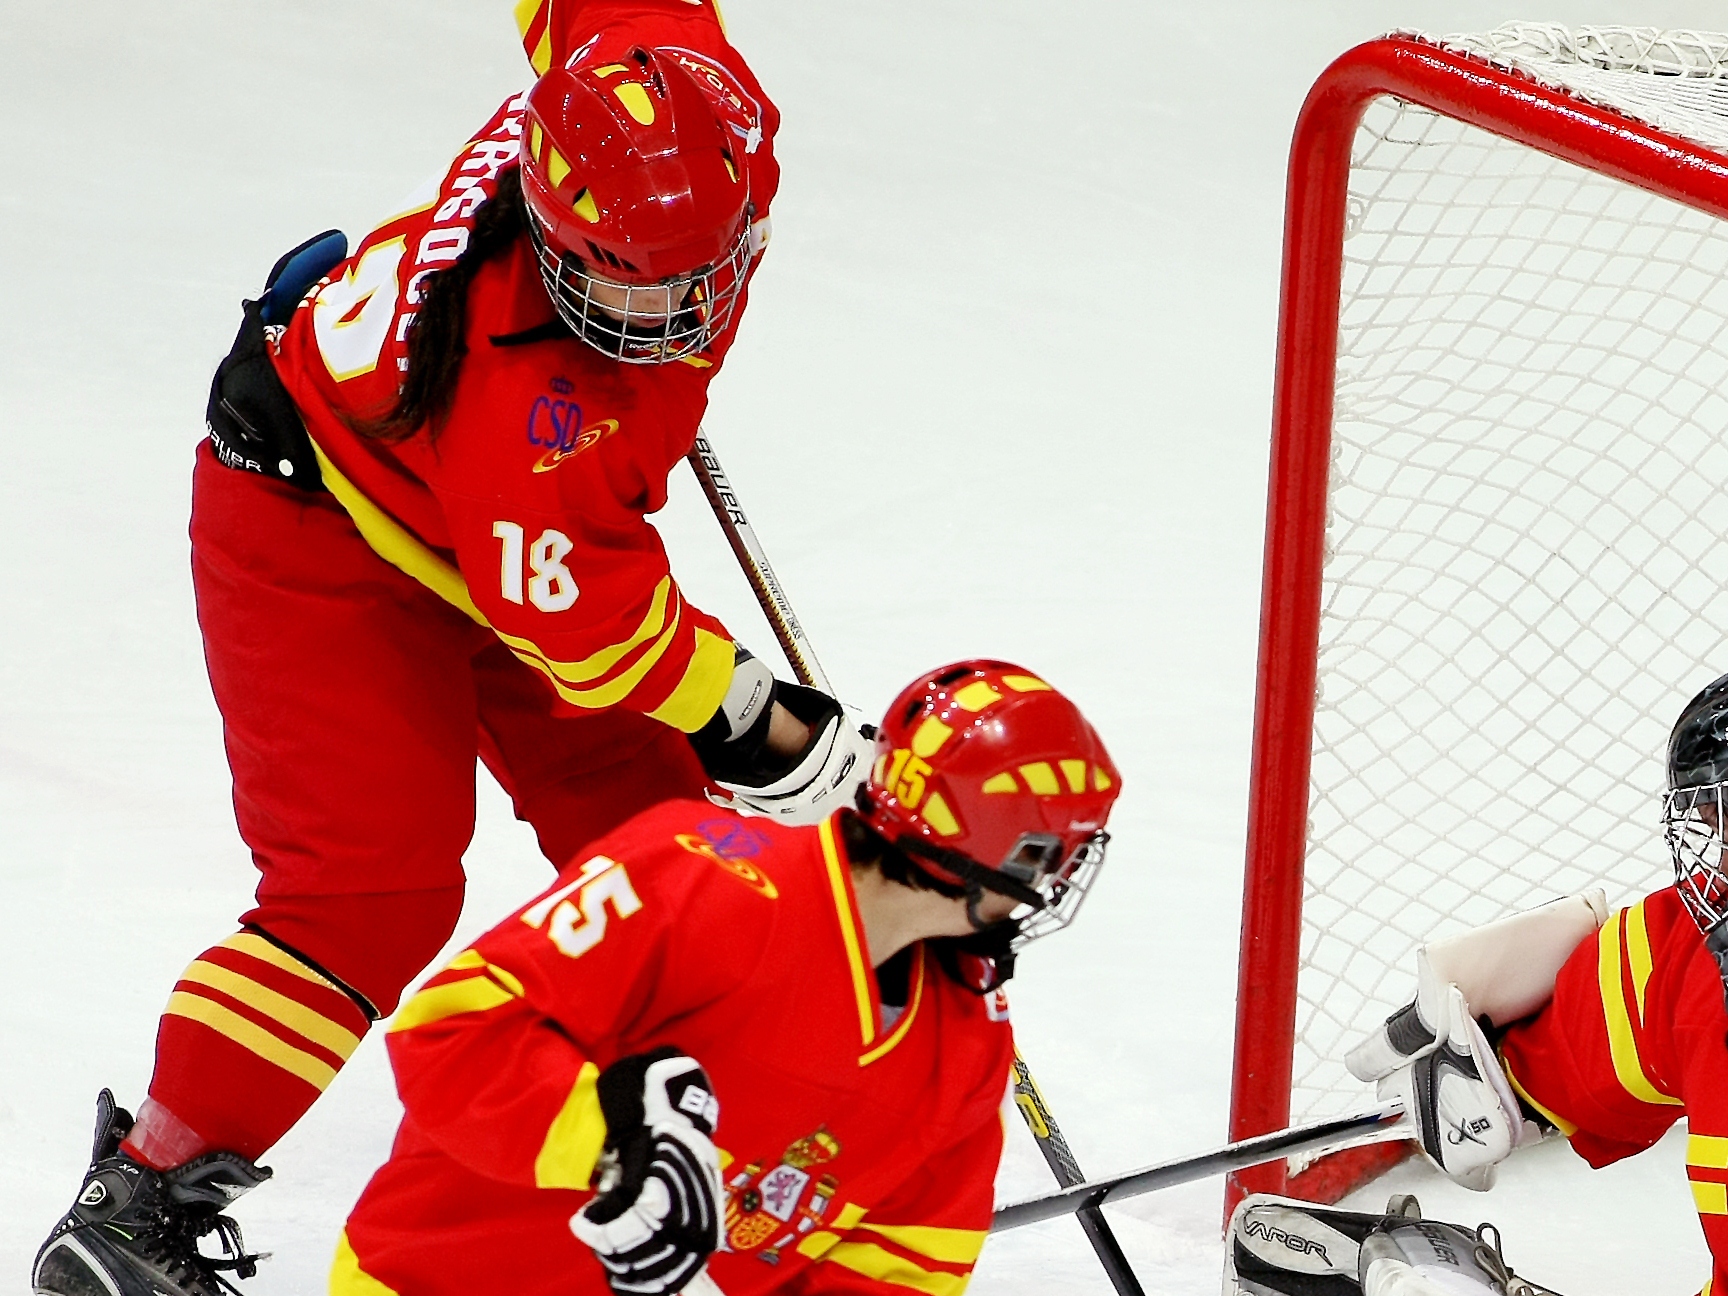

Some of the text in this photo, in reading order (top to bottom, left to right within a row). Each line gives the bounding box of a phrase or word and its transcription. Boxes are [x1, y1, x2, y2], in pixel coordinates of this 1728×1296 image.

[528, 395, 582, 451] CSD
[696, 438, 747, 527] BAUER
[492, 520, 580, 613] 18
[886, 747, 934, 810] 15
[519, 854, 643, 959] 15
[1243, 1219, 1334, 1268] VAPOR
